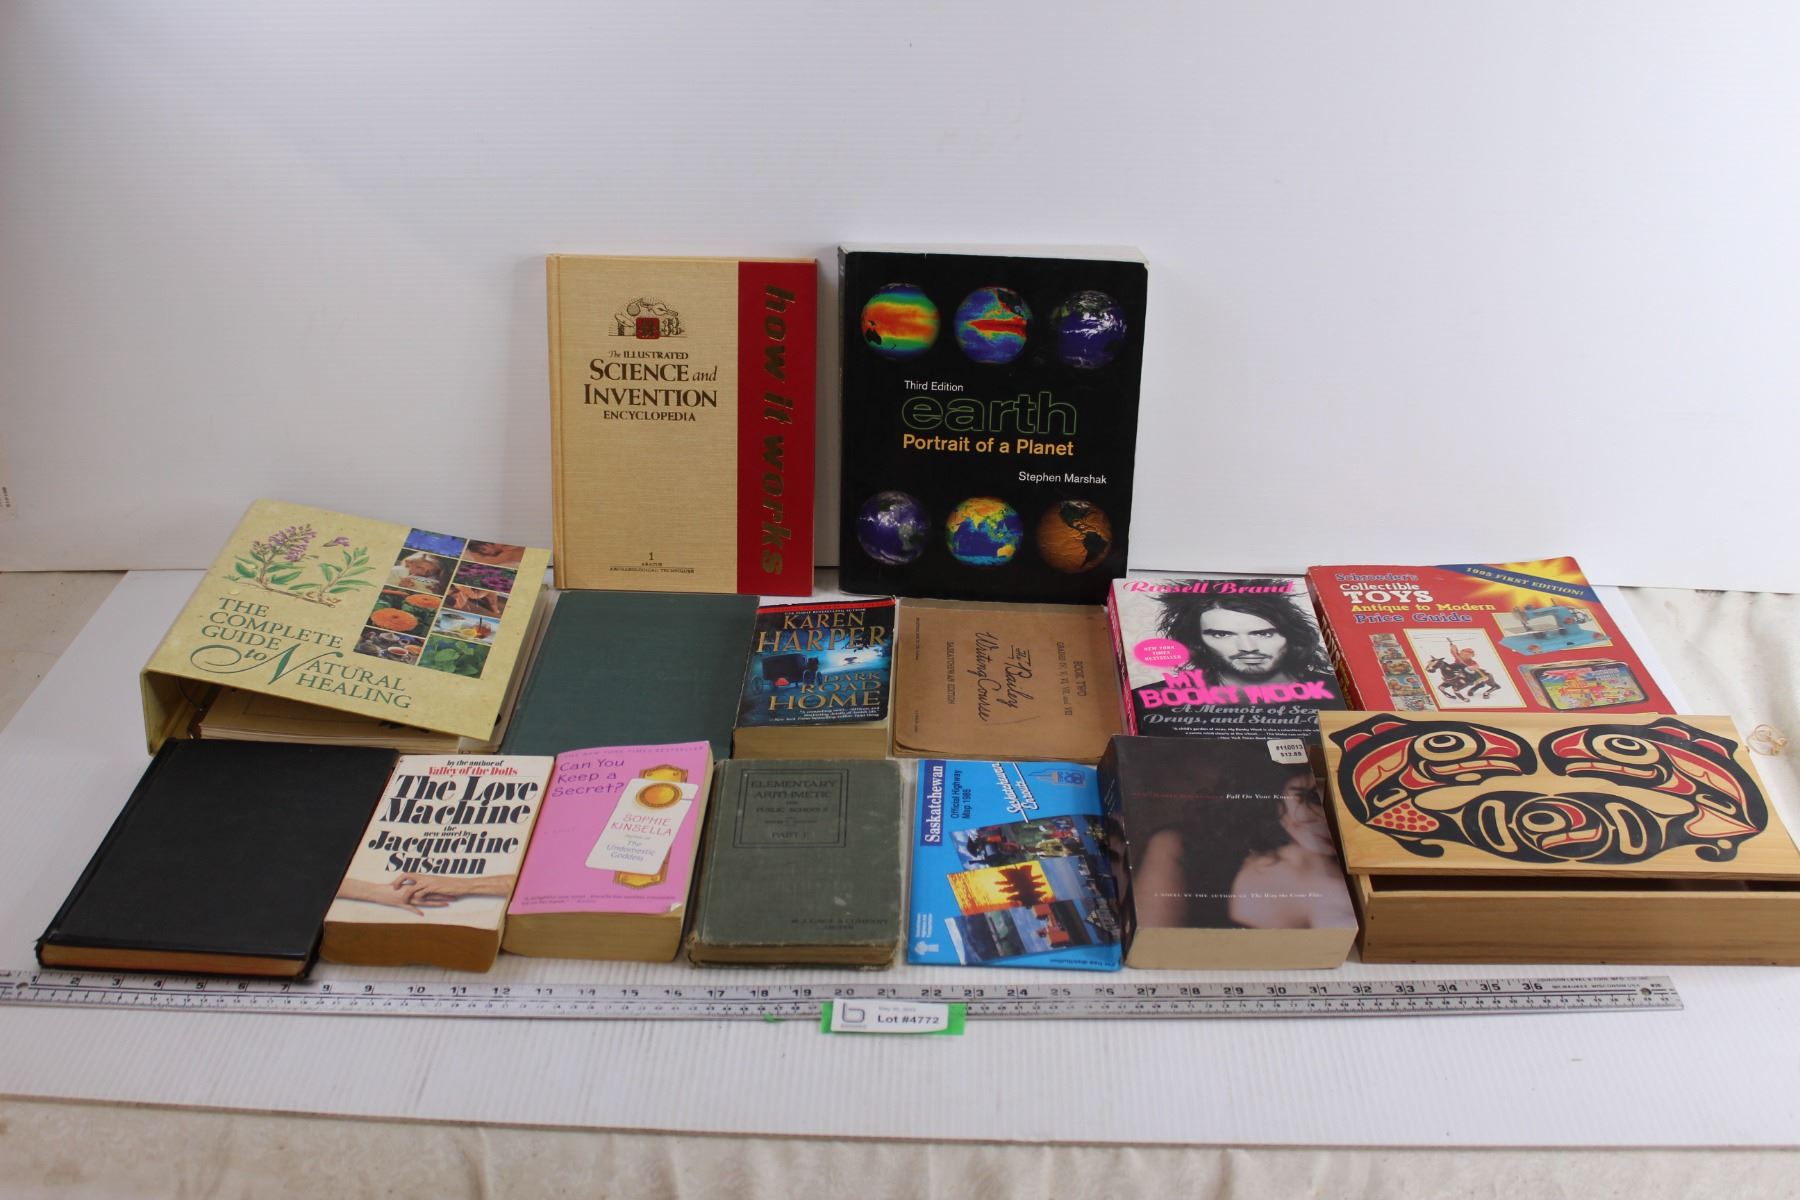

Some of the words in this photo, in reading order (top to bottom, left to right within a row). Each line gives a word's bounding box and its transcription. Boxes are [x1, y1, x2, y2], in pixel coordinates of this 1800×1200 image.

[764, 283, 796, 384] how
[608, 350, 621, 358] The
[623, 350, 689, 360] ILLUSTRATED
[589, 358, 689, 382] SCIENCE
[692, 365, 718, 382] and
[584, 383, 718, 408] INVENTION
[903, 380, 929, 391] Third
[931, 381, 964, 393] Edition
[603, 410, 696, 422] ENCYCLOPEDIA
[763, 390, 794, 425] it
[901, 391, 1077, 436] earth
[903, 433, 970, 453] Portrait
[975, 437, 995, 453] of
[999, 441, 1010, 454] a
[1016, 438, 1075, 456] Planet
[1018, 471, 1061, 484] Stephen
[1064, 473, 1108, 485] Marshak
[760, 434, 792, 576] works
[648, 551, 655, 561] 1
[1123, 580, 1210, 594] Russell
[1212, 581, 1295, 594] Brand
[1336, 573, 1419, 582] Schroeder's
[1339, 583, 1420, 591] Collectible
[1495, 573, 1530, 586] FIRST
[1531, 581, 1585, 597] EDITION!
[218, 597, 270, 618] THE
[1342, 590, 1434, 604] TOYS
[1351, 604, 1410, 613] Antique
[1415, 604, 1431, 612] to
[1436, 603, 1496, 611] Modern
[1354, 613, 1405, 624] Price
[1411, 613, 1473, 623] Guide
[209, 611, 344, 650] COMPLETE
[783, 612, 865, 630] KAREN
[201, 625, 282, 651] GUIDE
[756, 625, 886, 653] HARPER
[967, 631, 999, 678] Writing
[243, 648, 268, 662] to
[262, 643, 408, 692] NATURAL
[823, 672, 881, 683] DARK
[801, 681, 881, 694] ROAD
[996, 661, 1034, 709] Bailey
[1162, 669, 1208, 690] MY
[296, 672, 413, 709] HEALING
[768, 690, 881, 711] HOME
[977, 677, 1002, 723] Course
[1138, 684, 1240, 709] BOOKY
[1243, 680, 1335, 704] WOOK
[1143, 713, 1207, 726] Drugs,
[1210, 714, 1246, 724] and
[1171, 704, 1193, 714] A
[1194, 705, 1264, 715] Memoir
[1267, 706, 1285, 716] of
[428, 767, 458, 778] Valley
[458, 767, 471, 776] of
[471, 767, 489, 776] the
[490, 767, 519, 776] Dolls
[456, 759, 469, 767] the
[559, 760, 592, 772] Can
[598, 758, 625, 768] You
[394, 774, 457, 801] The
[460, 775, 539, 801] Love
[556, 773, 600, 785] Keep
[606, 772, 617, 780] a
[952, 769, 963, 794] Highway
[551, 782, 625, 797] Secret?
[379, 797, 531, 825] Machine
[924, 765, 944, 843] Saskatchewan
[950, 793, 960, 819] Official
[962, 804, 973, 819] Map
[610, 821, 672, 837] KINSELLA
[622, 813, 673, 827] SOPHIE
[368, 830, 519, 858] Jacqueline
[385, 852, 487, 875] Susann
[154, 979, 162, 987] 4
[408, 986, 426, 994] 10
[493, 987, 511, 995] 12
[707, 990, 725, 998] 17
[750, 990, 769, 998] 18
[792, 989, 811, 997] 19
[921, 988, 943, 997] 22
[964, 989, 984, 997] 23
[1007, 988, 1028, 997] 24
[1137, 987, 1157, 995] 27
[1180, 987, 1201, 995] 28
[1223, 987, 1244, 995] 29
[1266, 986, 1287, 994] 30
[1309, 986, 1328, 994] 31
[1352, 985, 1372, 993] 32
[1395, 985, 1415, 993] 33
[1437, 984, 1458, 992] 34
[877, 1015, 898, 1024] Lot
[902, 1015, 940, 1024] #4772
